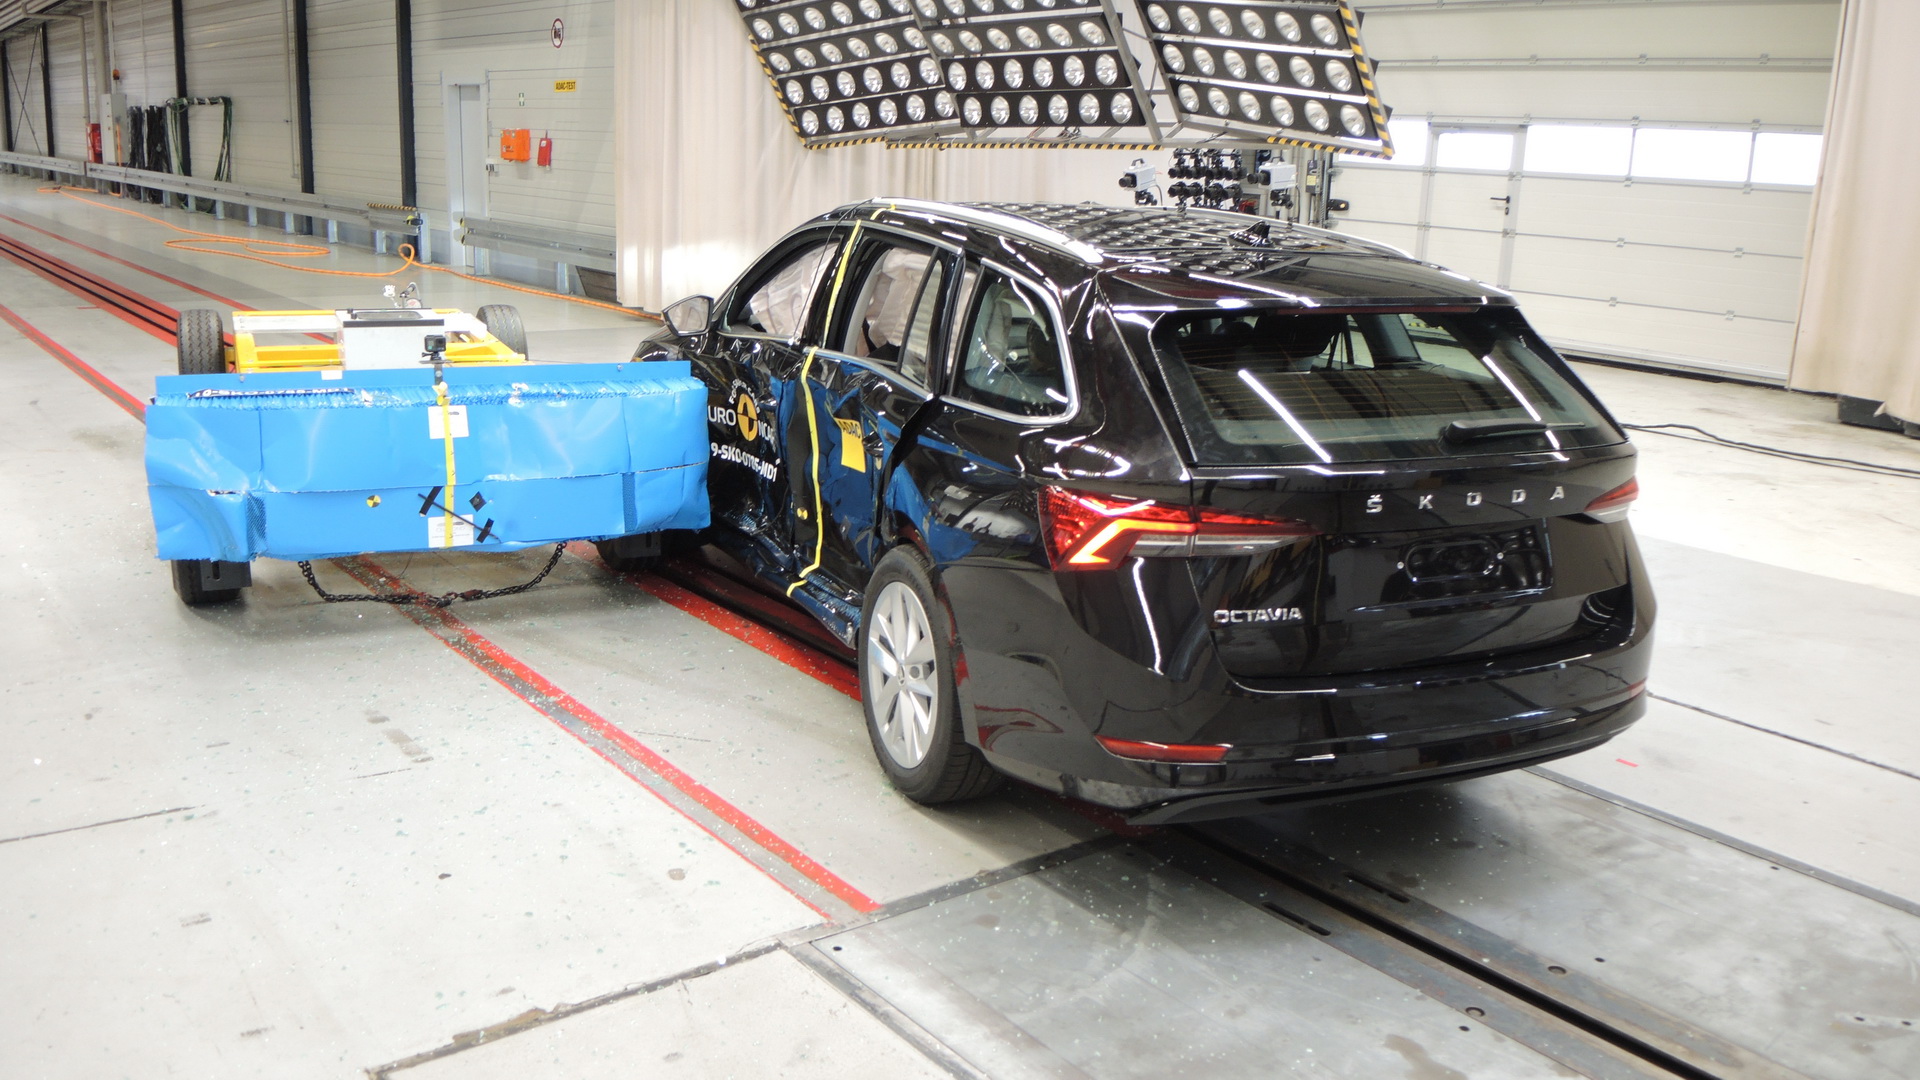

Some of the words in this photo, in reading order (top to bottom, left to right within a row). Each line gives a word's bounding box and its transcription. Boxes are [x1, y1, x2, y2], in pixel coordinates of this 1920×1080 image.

[708, 405, 736, 426] URO
[841, 420, 861, 439] ADAC
[1366, 486, 1565, 513] ŠKODA
[1213, 607, 1302, 623] OCTAVIA
